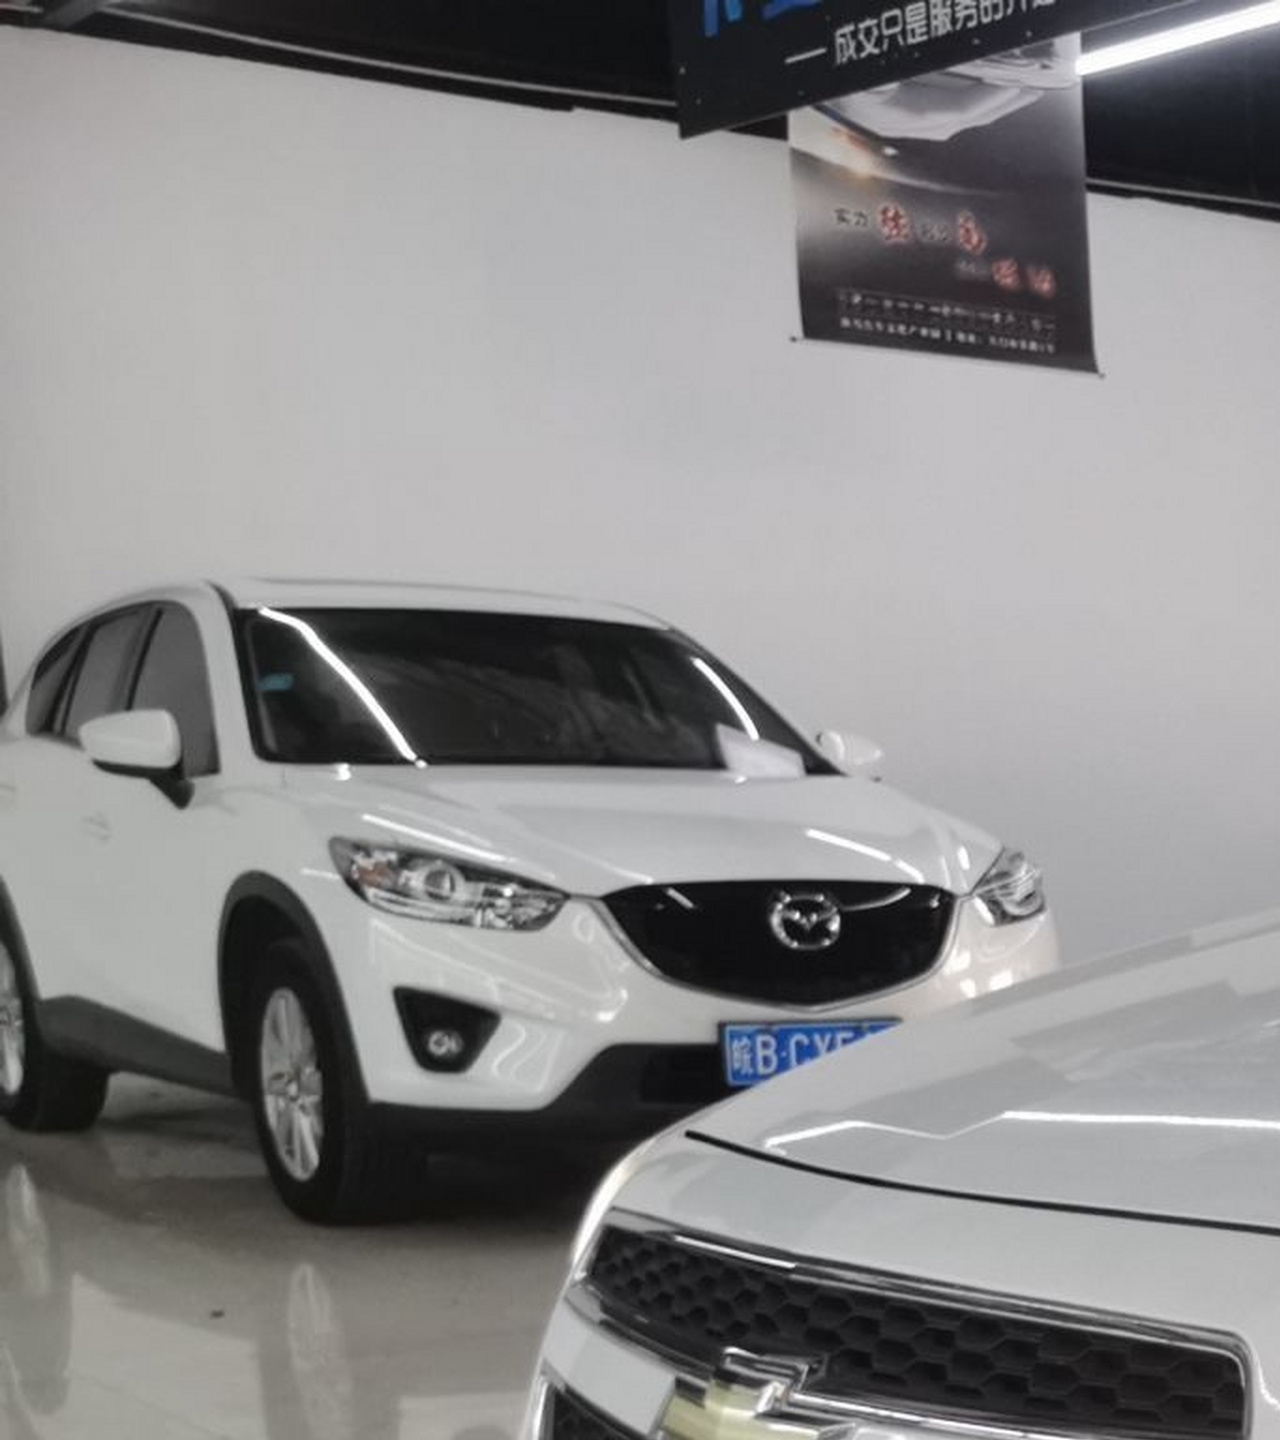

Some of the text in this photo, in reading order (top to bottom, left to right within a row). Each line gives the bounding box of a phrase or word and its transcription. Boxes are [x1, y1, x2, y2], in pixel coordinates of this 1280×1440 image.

[834, 0, 1055, 65] 成交只是服务的
